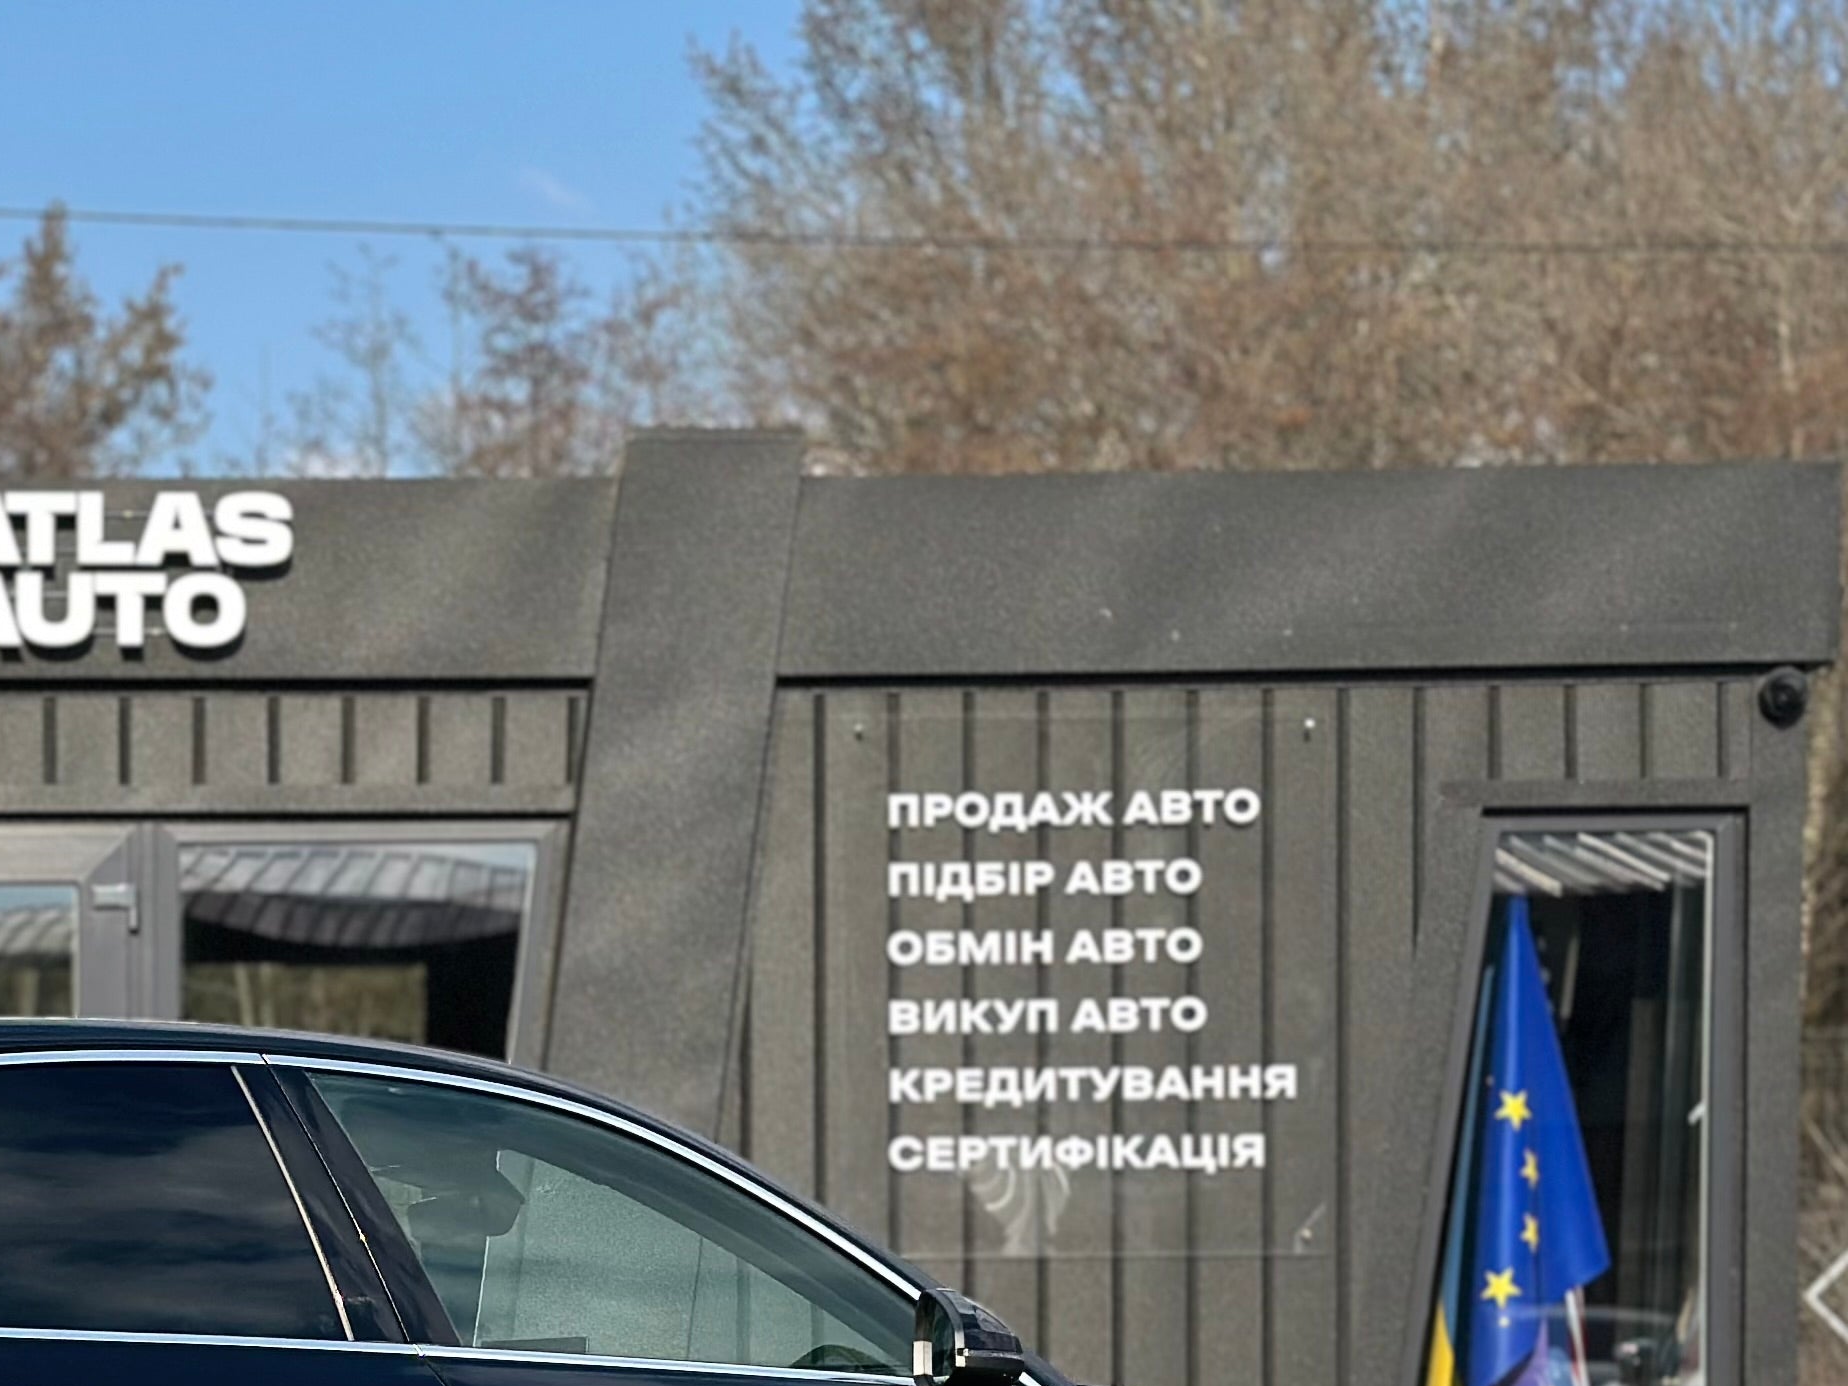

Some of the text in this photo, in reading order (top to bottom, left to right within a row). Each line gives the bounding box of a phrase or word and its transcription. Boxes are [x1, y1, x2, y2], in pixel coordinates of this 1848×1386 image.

[888, 788, 1261, 833] ПРОДАЖ АВТО
[888, 858, 1202, 902] ПІДБІР АВТО
[887, 927, 1203, 966] ОБМІН АВТО
[889, 996, 1208, 1034] ВИКУП АВТО
[889, 1064, 1297, 1108] КРЕДИТУВАННЯ
[888, 1133, 1265, 1175] СЕРТИФІКАЦІЯ
